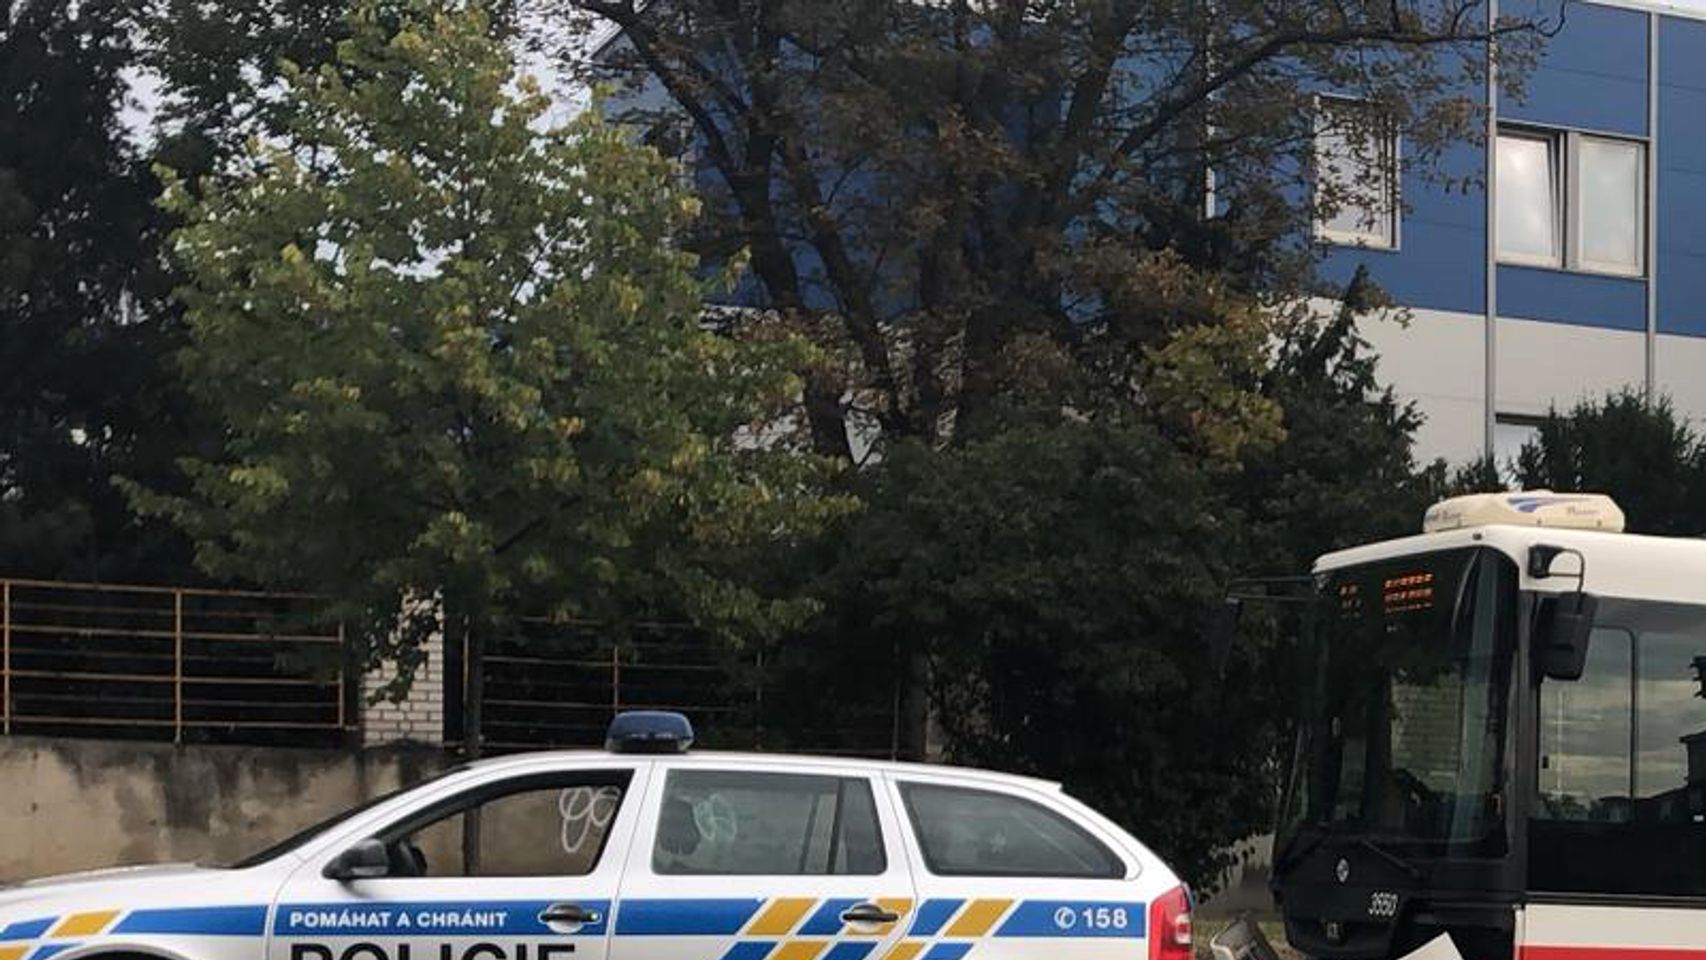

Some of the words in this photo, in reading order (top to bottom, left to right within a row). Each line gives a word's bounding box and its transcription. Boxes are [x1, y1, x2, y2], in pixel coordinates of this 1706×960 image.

[289, 909, 391, 928] POMÁHAT
[396, 911, 411, 928] A
[418, 909, 508, 928] CHRÁNIT
[1082, 907, 1128, 929] 158
